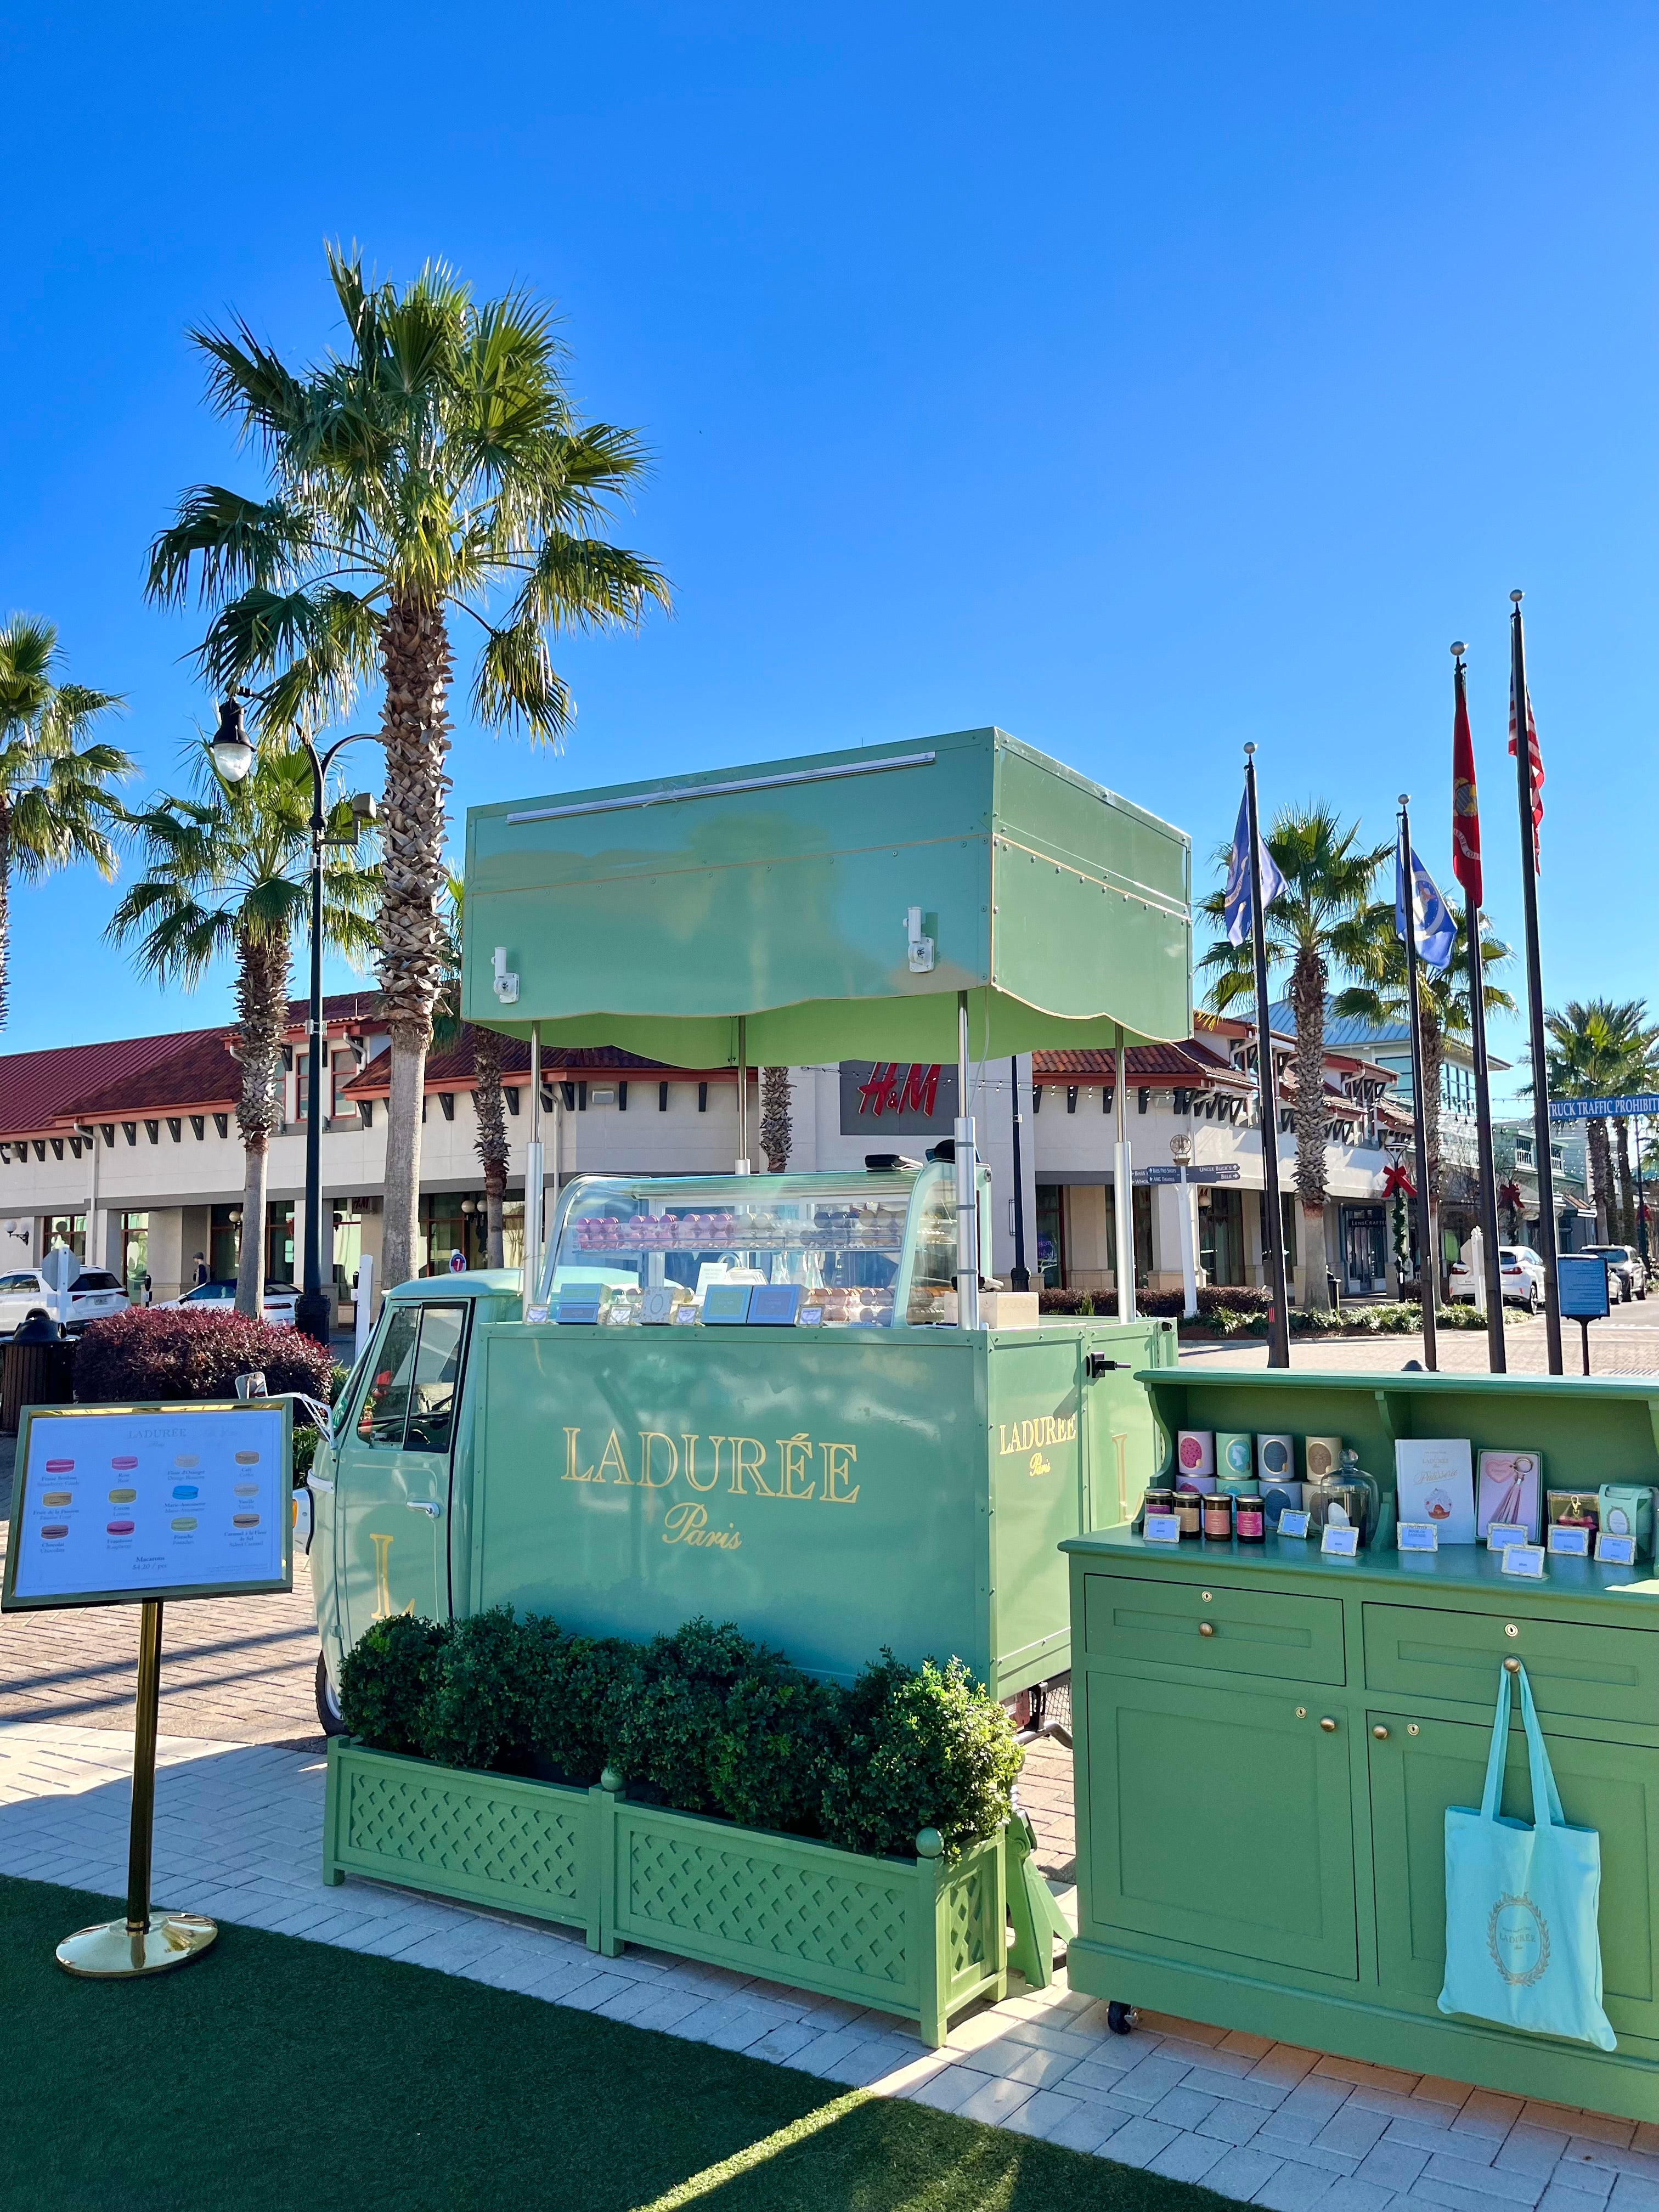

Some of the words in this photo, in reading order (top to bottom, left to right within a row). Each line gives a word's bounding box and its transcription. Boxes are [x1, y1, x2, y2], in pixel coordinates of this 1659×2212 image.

[857, 1062, 941, 1116] H&M
[1549, 1102, 1576, 1116] TRUCK
[1577, 1100, 1613, 1115] TRAFFIC
[1615, 1097, 1659, 1113] PROHIBIT
[456, 1259, 460, 1271] 7
[560, 1426, 860, 1504] LADURÉE
[1029, 1452, 1051, 1476] Paris
[662, 1502, 742, 1550] Paris
